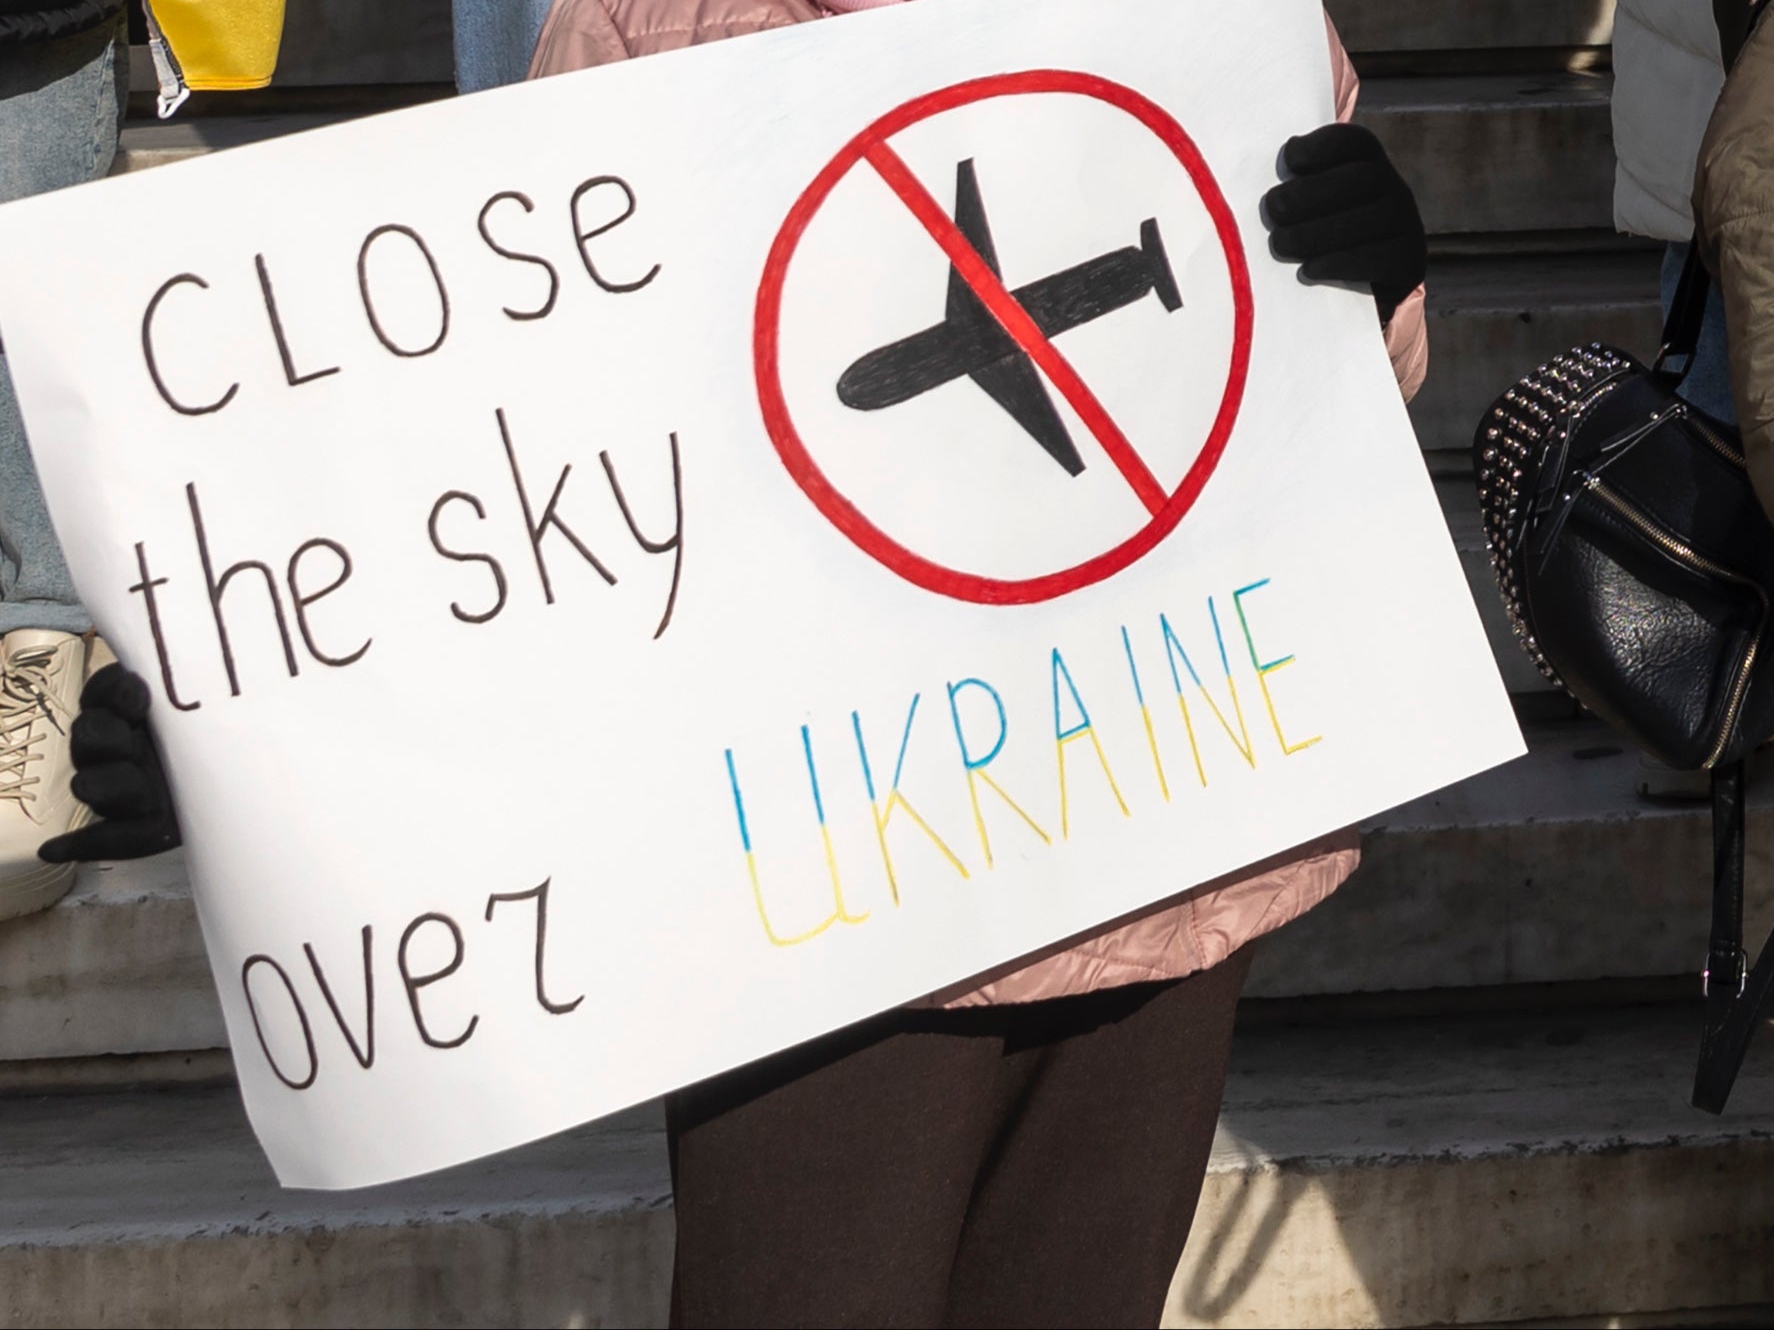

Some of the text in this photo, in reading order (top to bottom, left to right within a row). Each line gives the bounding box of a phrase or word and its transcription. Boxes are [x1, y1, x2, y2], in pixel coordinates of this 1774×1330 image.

[127, 405, 689, 713] the sky
[240, 575, 1326, 1093] over UKRAINE
